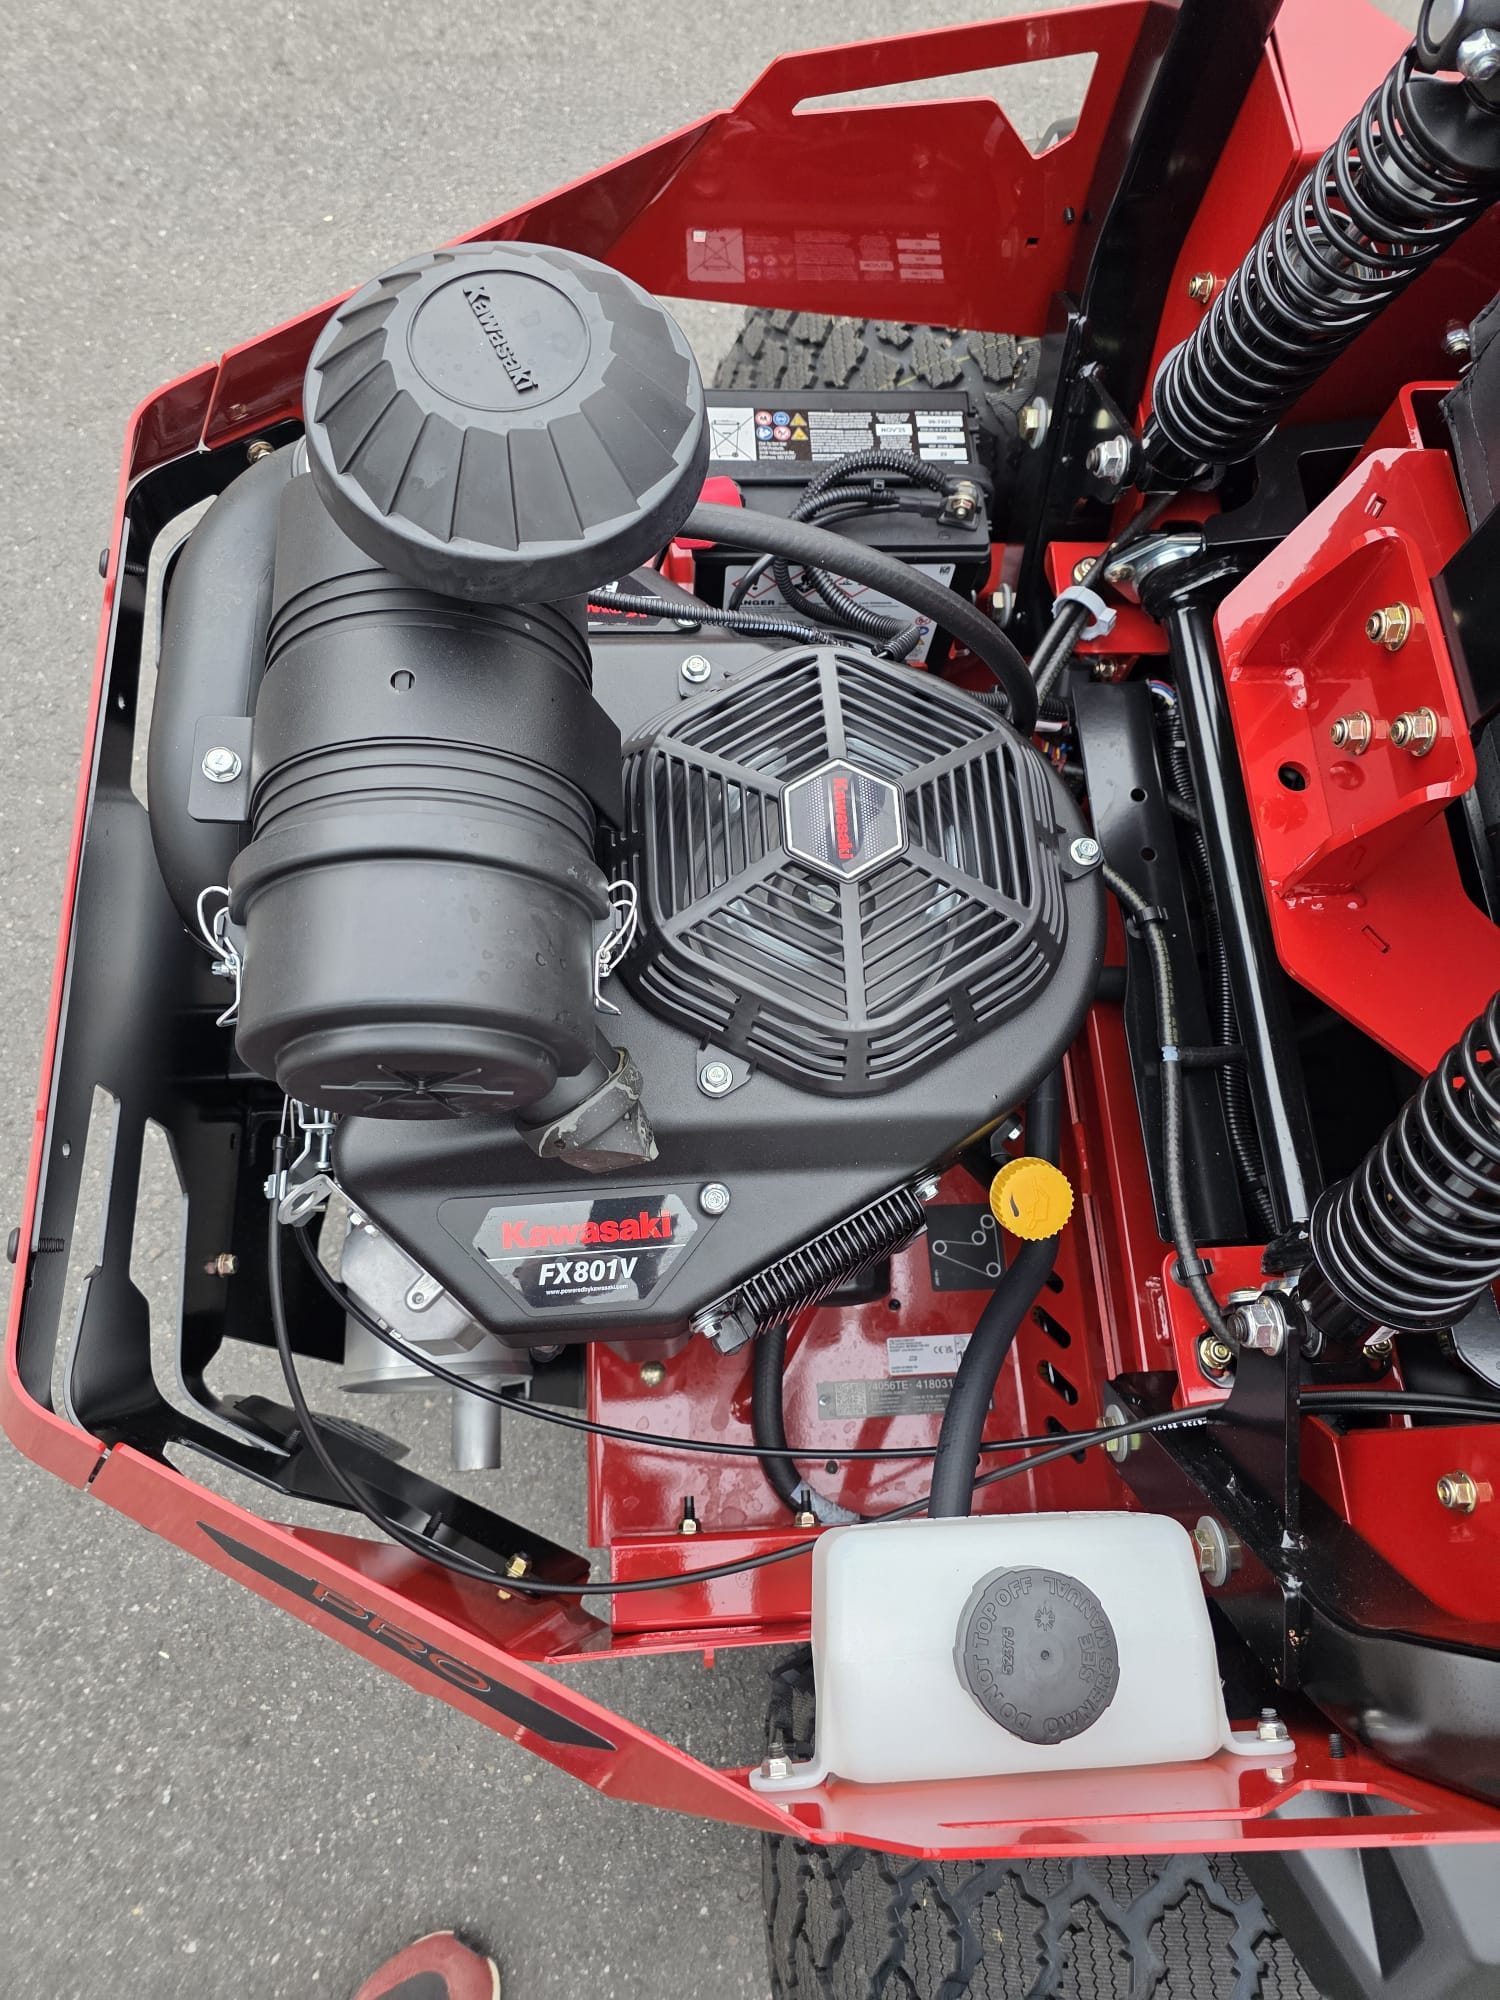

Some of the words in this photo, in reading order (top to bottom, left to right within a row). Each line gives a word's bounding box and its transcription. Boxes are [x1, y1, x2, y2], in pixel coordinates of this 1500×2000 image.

[463, 286, 538, 394] Kawasaki
[833, 778, 854, 860] Kawasaki
[502, 1210, 672, 1250] Kawasaki
[538, 1257, 638, 1286] FX801V
[546, 1284, 628, 1296] www.poweredbykawasaki.com
[916, 1378, 955, 1390] 418031
[995, 1576, 1032, 1607] OFF
[1044, 1576, 1112, 1650] MANUAL
[973, 1603, 998, 1648] TOP
[1002, 1626, 1015, 1676] 52375
[1078, 1633, 1096, 1681] SEE
[973, 1654, 1003, 1706] NOT
[1043, 1656, 1113, 1735] OWNERS
[1000, 1702, 1032, 1730] DO
